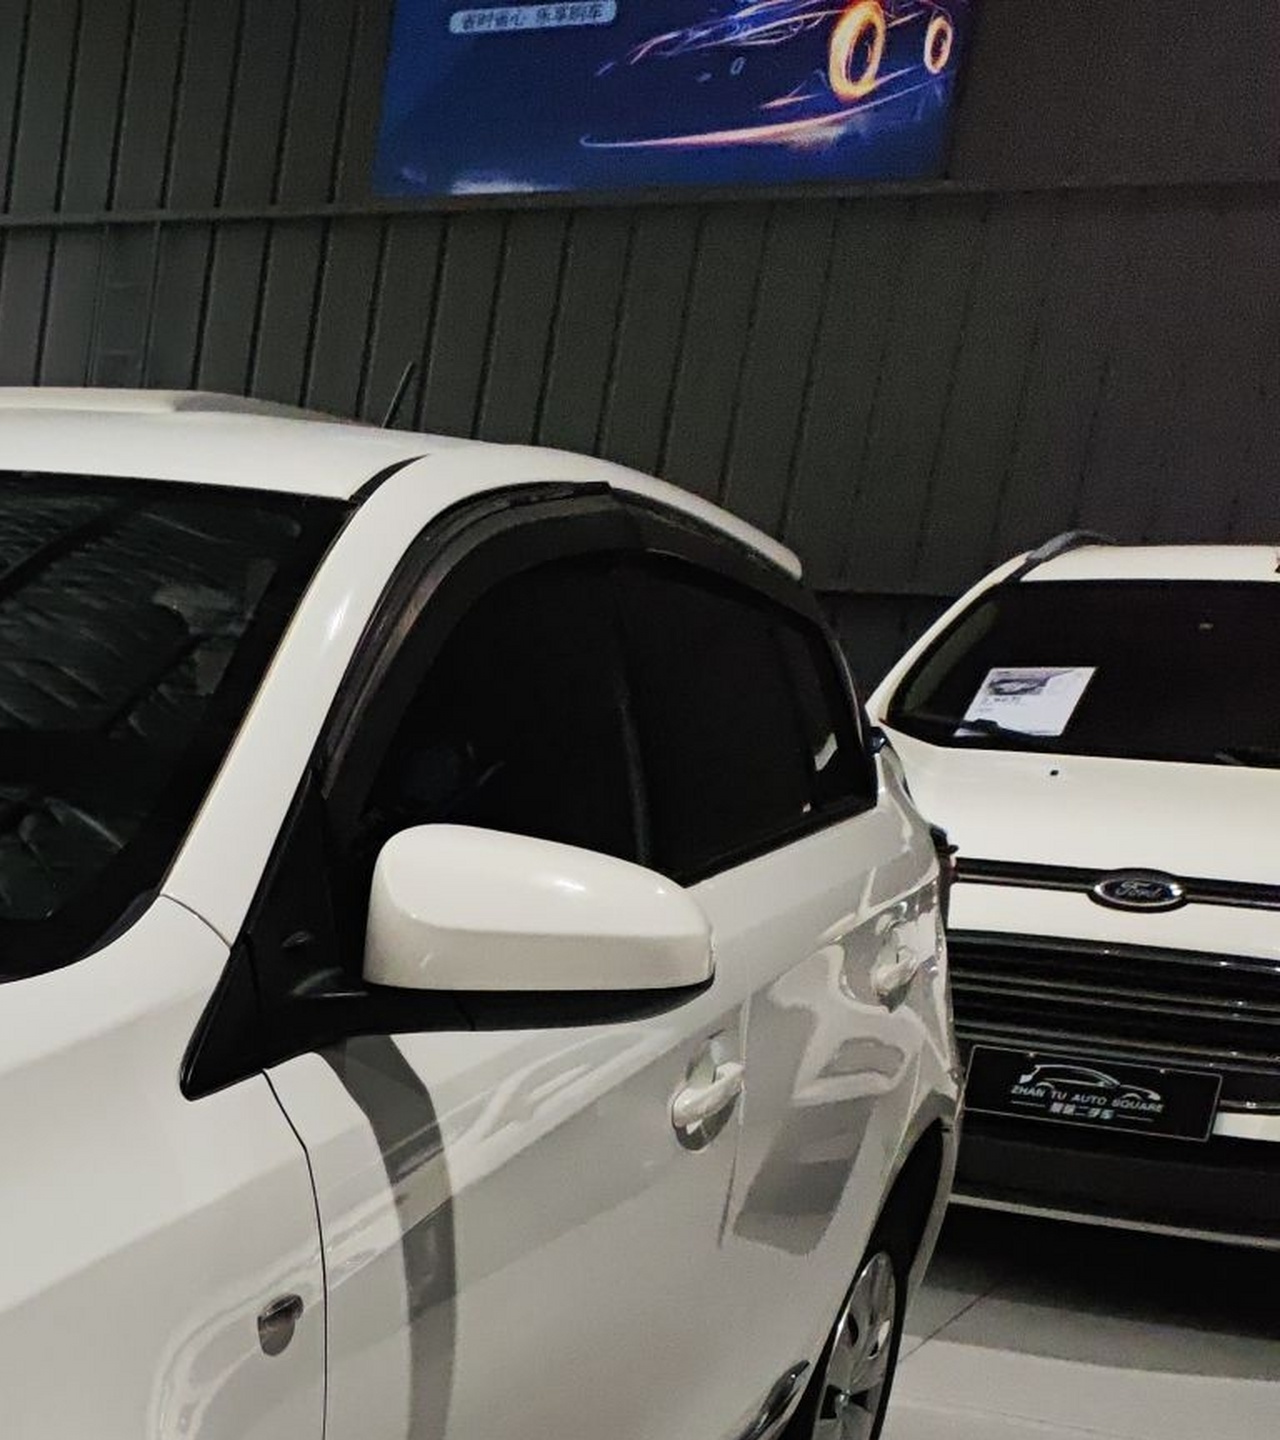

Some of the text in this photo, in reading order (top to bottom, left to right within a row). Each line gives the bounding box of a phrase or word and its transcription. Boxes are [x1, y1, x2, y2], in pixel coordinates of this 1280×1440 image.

[1011, 1085, 1165, 1113] ZHAN TU AUTO SQUARE
